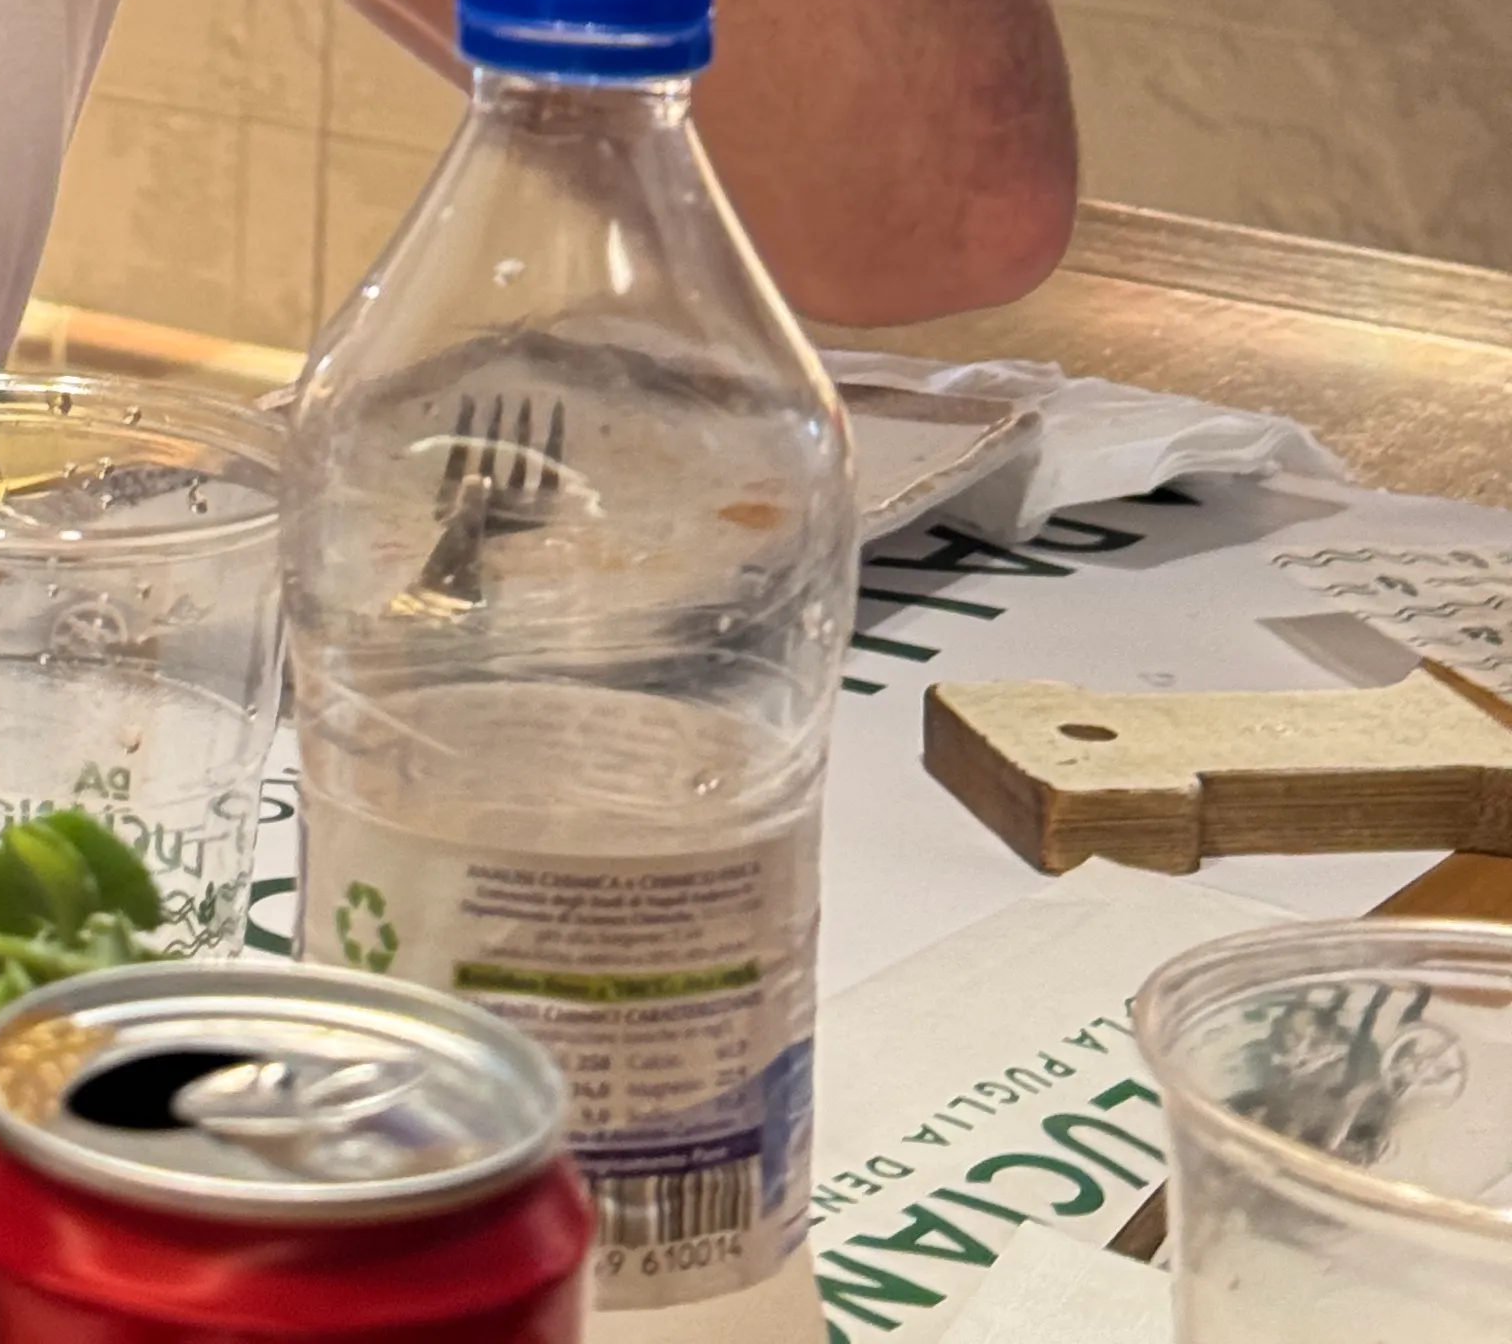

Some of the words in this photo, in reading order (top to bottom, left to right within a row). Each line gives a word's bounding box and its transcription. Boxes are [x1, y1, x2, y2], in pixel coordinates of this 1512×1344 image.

[901, 1050, 1078, 1147] PUGLIA
[808, 1155, 916, 1229] DEN
[815, 1078, 1169, 1344] LUCIAN
